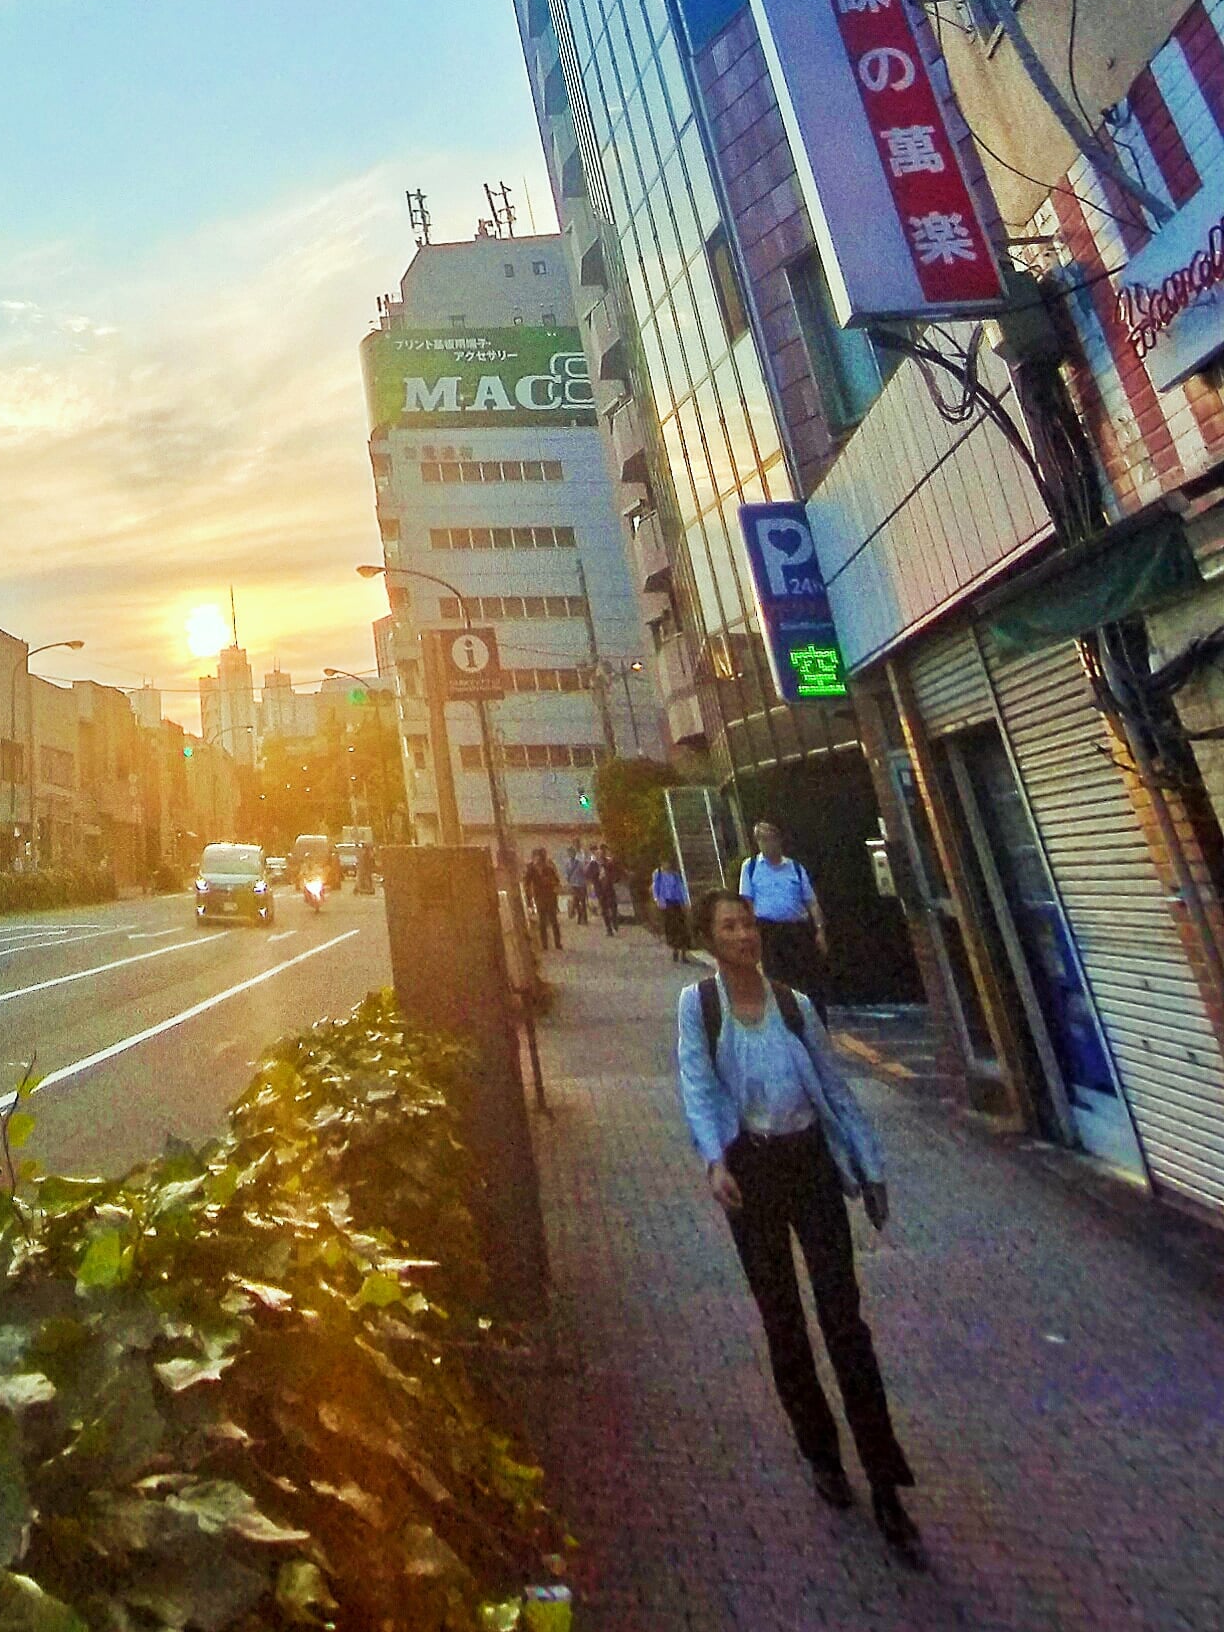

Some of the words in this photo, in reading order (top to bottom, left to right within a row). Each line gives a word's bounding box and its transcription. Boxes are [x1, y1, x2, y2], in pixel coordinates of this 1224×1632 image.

[454, 350, 519, 362] アクセサリー
[790, 644, 847, 696] 空
